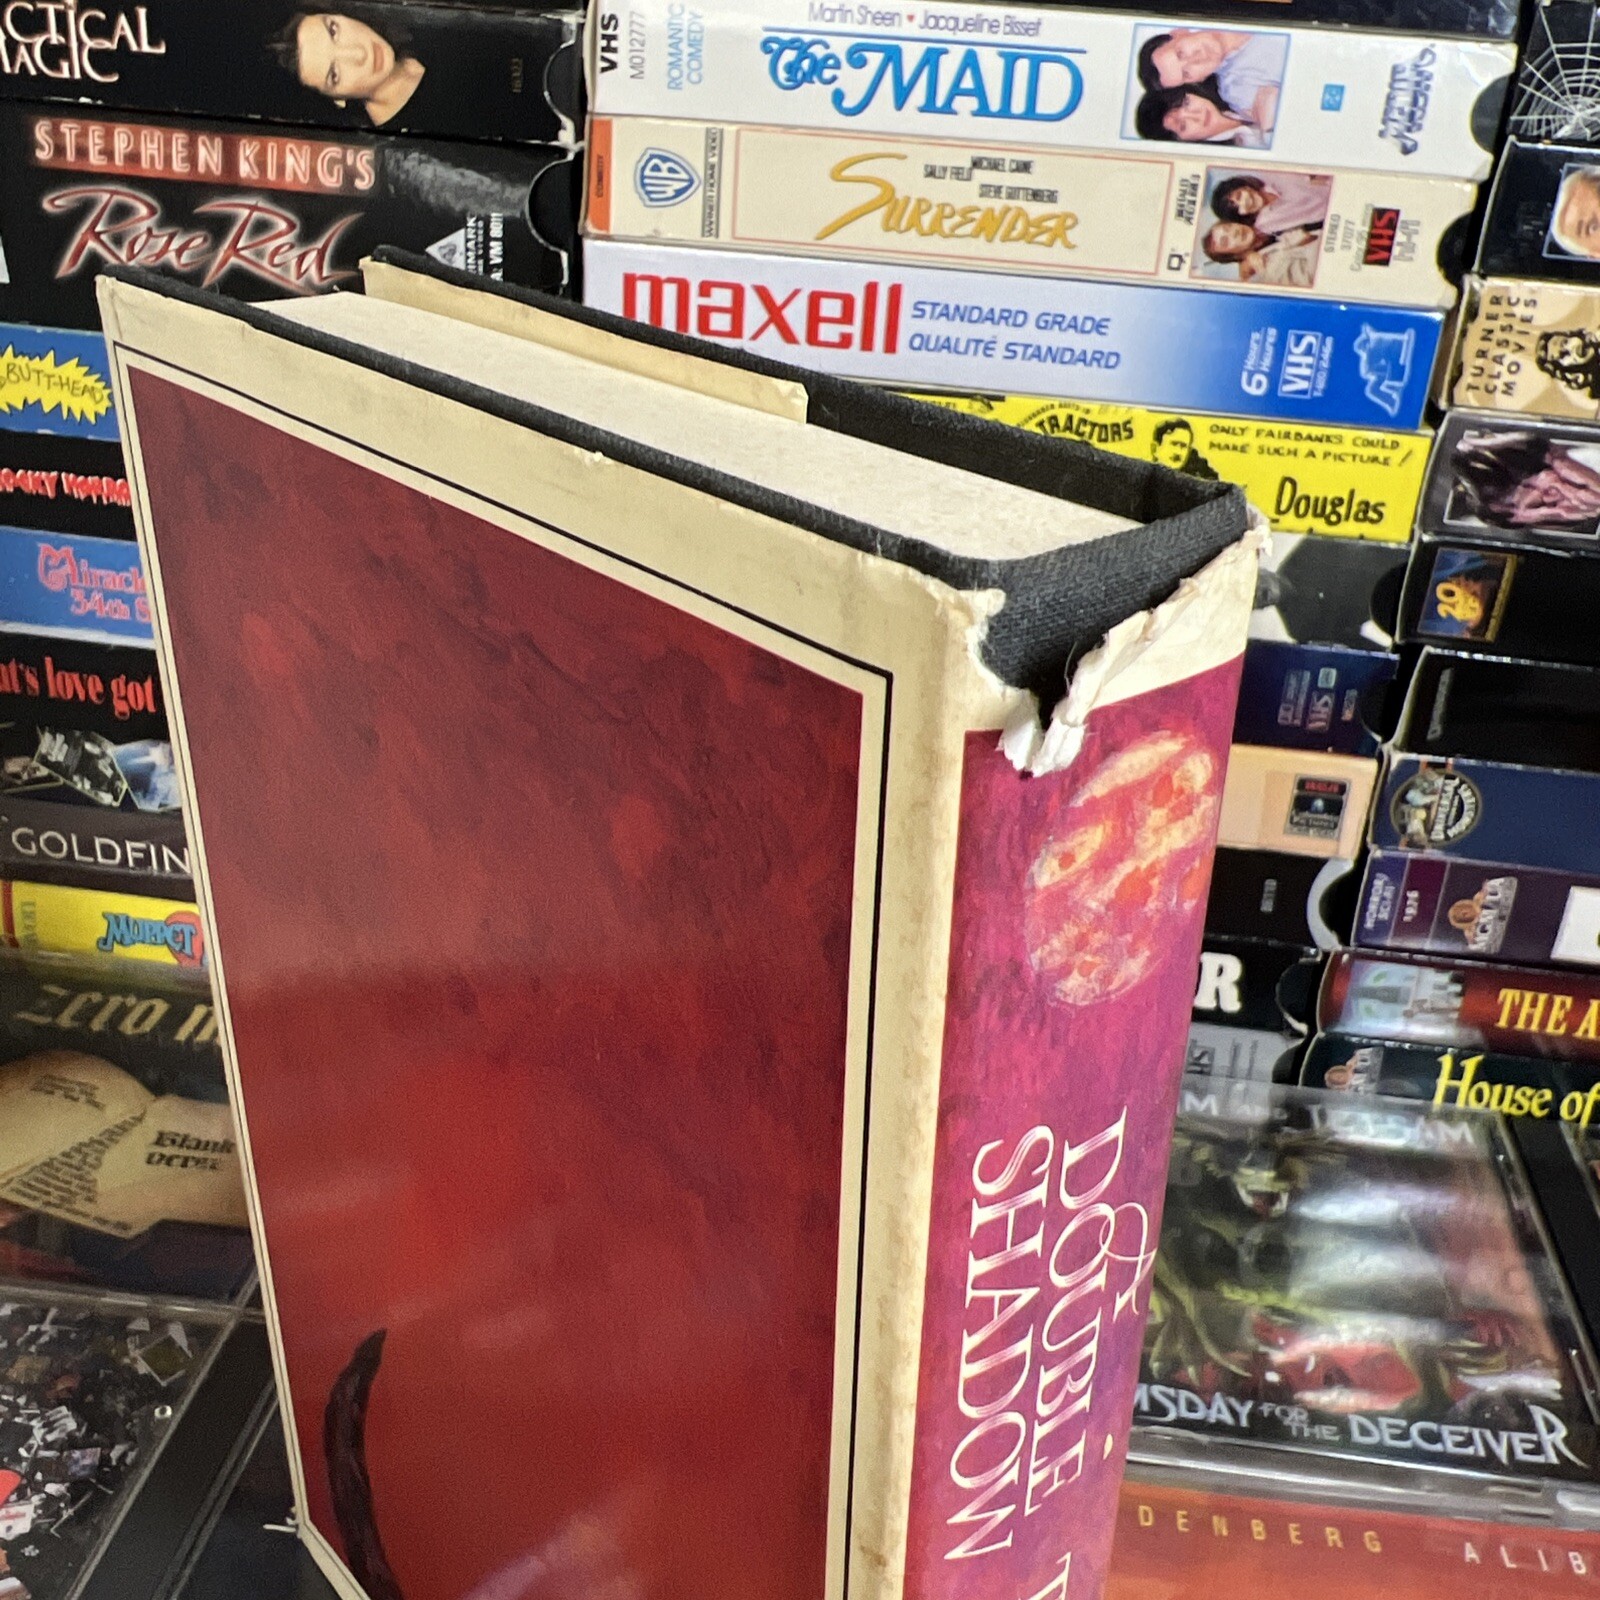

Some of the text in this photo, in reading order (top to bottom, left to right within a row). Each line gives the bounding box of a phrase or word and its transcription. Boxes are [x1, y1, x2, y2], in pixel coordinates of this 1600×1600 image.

[600, 13, 619, 74] VHS
[808, 2, 1042, 37] Martin Sheen Jacqueline Bisset
[629, 11, 646, 80] M012777
[667, 3, 685, 91] ROMANTIC
[686, 12, 705, 85] COMEDY
[760, 36, 1084, 122] The MAID
[34, 119, 376, 191] STEPHEN KING'S
[641, 155, 693, 202] WB
[923, 164, 973, 182] SALLY FIELD
[971, 155, 1034, 175] MICHAEL CAINE
[705, 127, 719, 238] WARNER HOME VIDEO
[978, 184, 1059, 204] STEVE GUTTENBERG
[41, 185, 366, 294] Rose Red
[1324, 213, 1341, 254] STEREO
[1365, 209, 1398, 263] VHS
[622, 272, 904, 354] maxell
[911, 301, 1112, 337] STANDARD GRADE
[909, 332, 1121, 370] QUALITÉ STANDARD
[1240, 331, 1269, 396] 6 Hours
[1259, 327, 1277, 372] Heures
[1281, 334, 1318, 393] VHS
[1466, 295, 1504, 391] TURNER
[1484, 296, 1521, 394] CLASSIC
[1501, 298, 1538, 397] MOVIES
[6, 361, 105, 405] BUTT-HEAD
[1035, 412, 1134, 443] TRACTORS
[1209, 424, 1400, 450] ONLY FAIRBANKS COULD
[1209, 441, 1250, 454] MAKE
[1257, 443, 1298, 458] SUCH
[1304, 449, 1316, 459] A
[0, 467, 132, 507] OCKY HORRO
[1274, 475, 1387, 526] Douglas
[71, 587, 132, 620] 34th
[44, 655, 105, 705] love
[110, 673, 157, 721] got
[11, 827, 192, 874] GOLDFIN
[96, 911, 197, 960] MUPPET
[1494, 987, 1573, 1037] THE
[1431, 1052, 1553, 1118] House
[1559, 1081, 1600, 1131] of
[1024, 1104, 1127, 1517] DOUBLE
[943, 1124, 1055, 1560] SHADOW
[1259, 1401, 1310, 1425] FOR
[1284, 1404, 1589, 1469] THE DECEIVER
[1137, 1505, 1382, 1553] DENBERG
